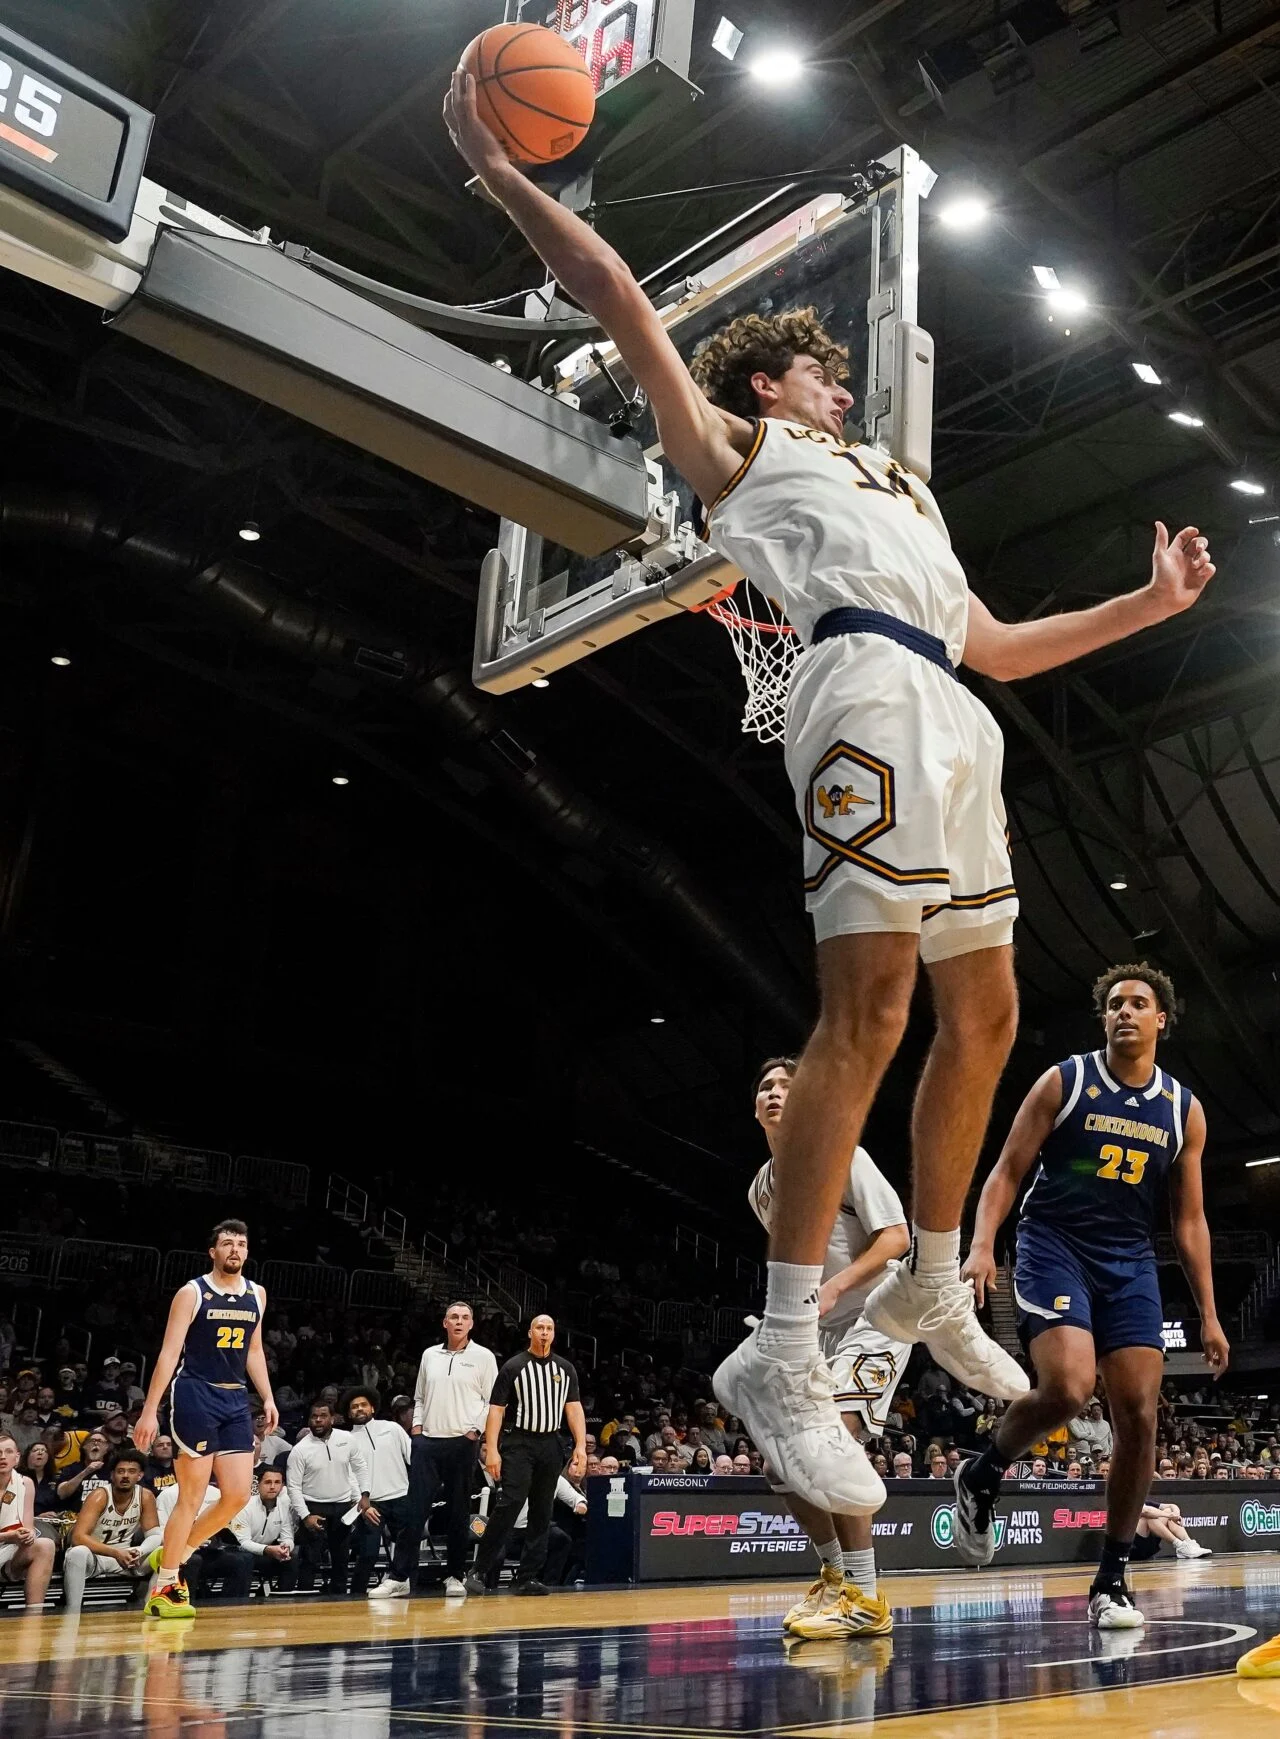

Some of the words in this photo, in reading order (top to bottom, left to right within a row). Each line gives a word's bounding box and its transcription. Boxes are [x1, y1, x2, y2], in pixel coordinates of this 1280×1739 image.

[1084, 1112, 1170, 1149] CHATTANOOGA
[1096, 1143, 1150, 1185] 23
[0, 1255, 29, 1272] 206
[216, 1326, 245, 1349] 22
[1163, 1338, 1187, 1348] ARTS
[647, 1477, 709, 1488] #DAWGSONLY
[1019, 1482, 1041, 1490] HINKLE
[1042, 1482, 1078, 1490] FIELDHOUSE
[101, 1517, 111, 1526] UC
[112, 1516, 139, 1527] IRVINE
[650, 1511, 806, 1537] SUPERSTAR
[1010, 1510, 1040, 1528] AUTO
[1180, 1515, 1218, 1528] XCLUSIVELY
[1219, 1515, 1229, 1527] AT
[900, 1522, 914, 1535] AT
[1007, 1527, 1043, 1546] PARTS
[729, 1540, 808, 1553] BATTERIES
